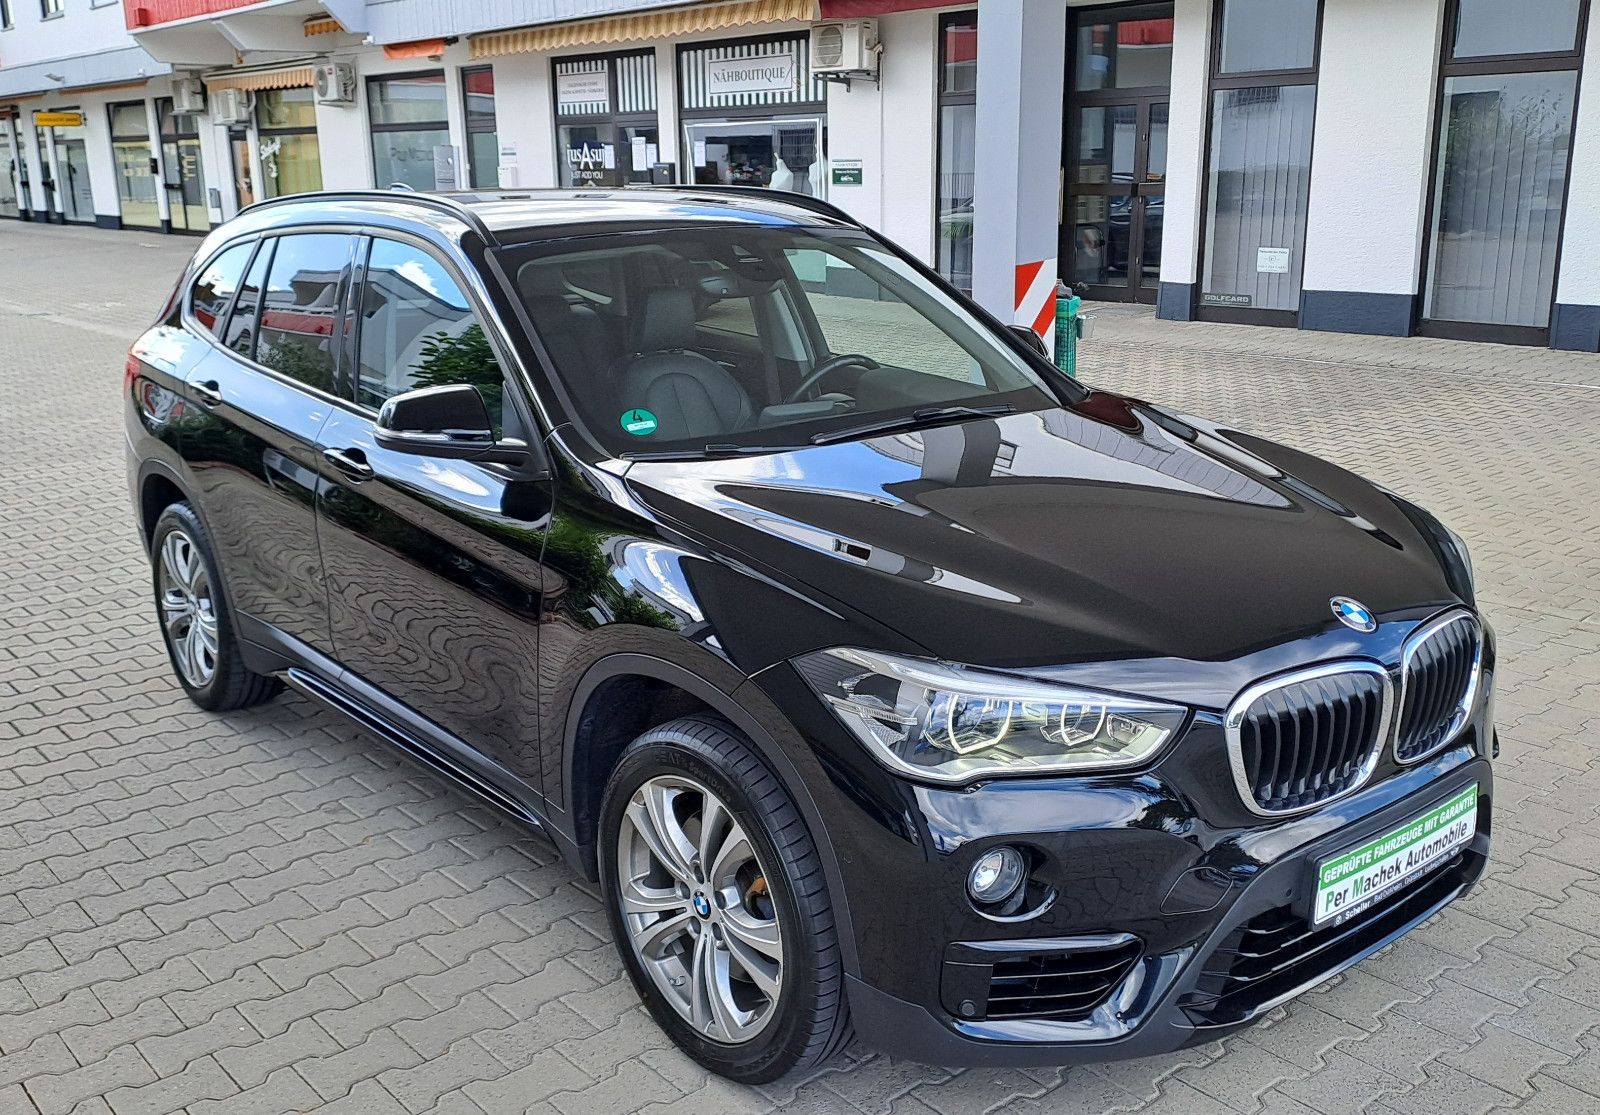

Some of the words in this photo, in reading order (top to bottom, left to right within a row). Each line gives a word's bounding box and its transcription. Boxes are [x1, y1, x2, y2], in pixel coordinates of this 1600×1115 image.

[713, 67, 785, 83] NÄHBOUTIQUE
[1204, 294, 1249, 303] GOLFCARD
[1323, 849, 1373, 884] GEPRÜFTE
[1373, 824, 1423, 860] FAHRZEUGE
[1423, 816, 1440, 834] MIT
[1439, 793, 1474, 823] GARANTIE
[1325, 888, 1349, 912] Per
[1352, 857, 1403, 900] Machek
[1404, 820, 1468, 871] Automobile
